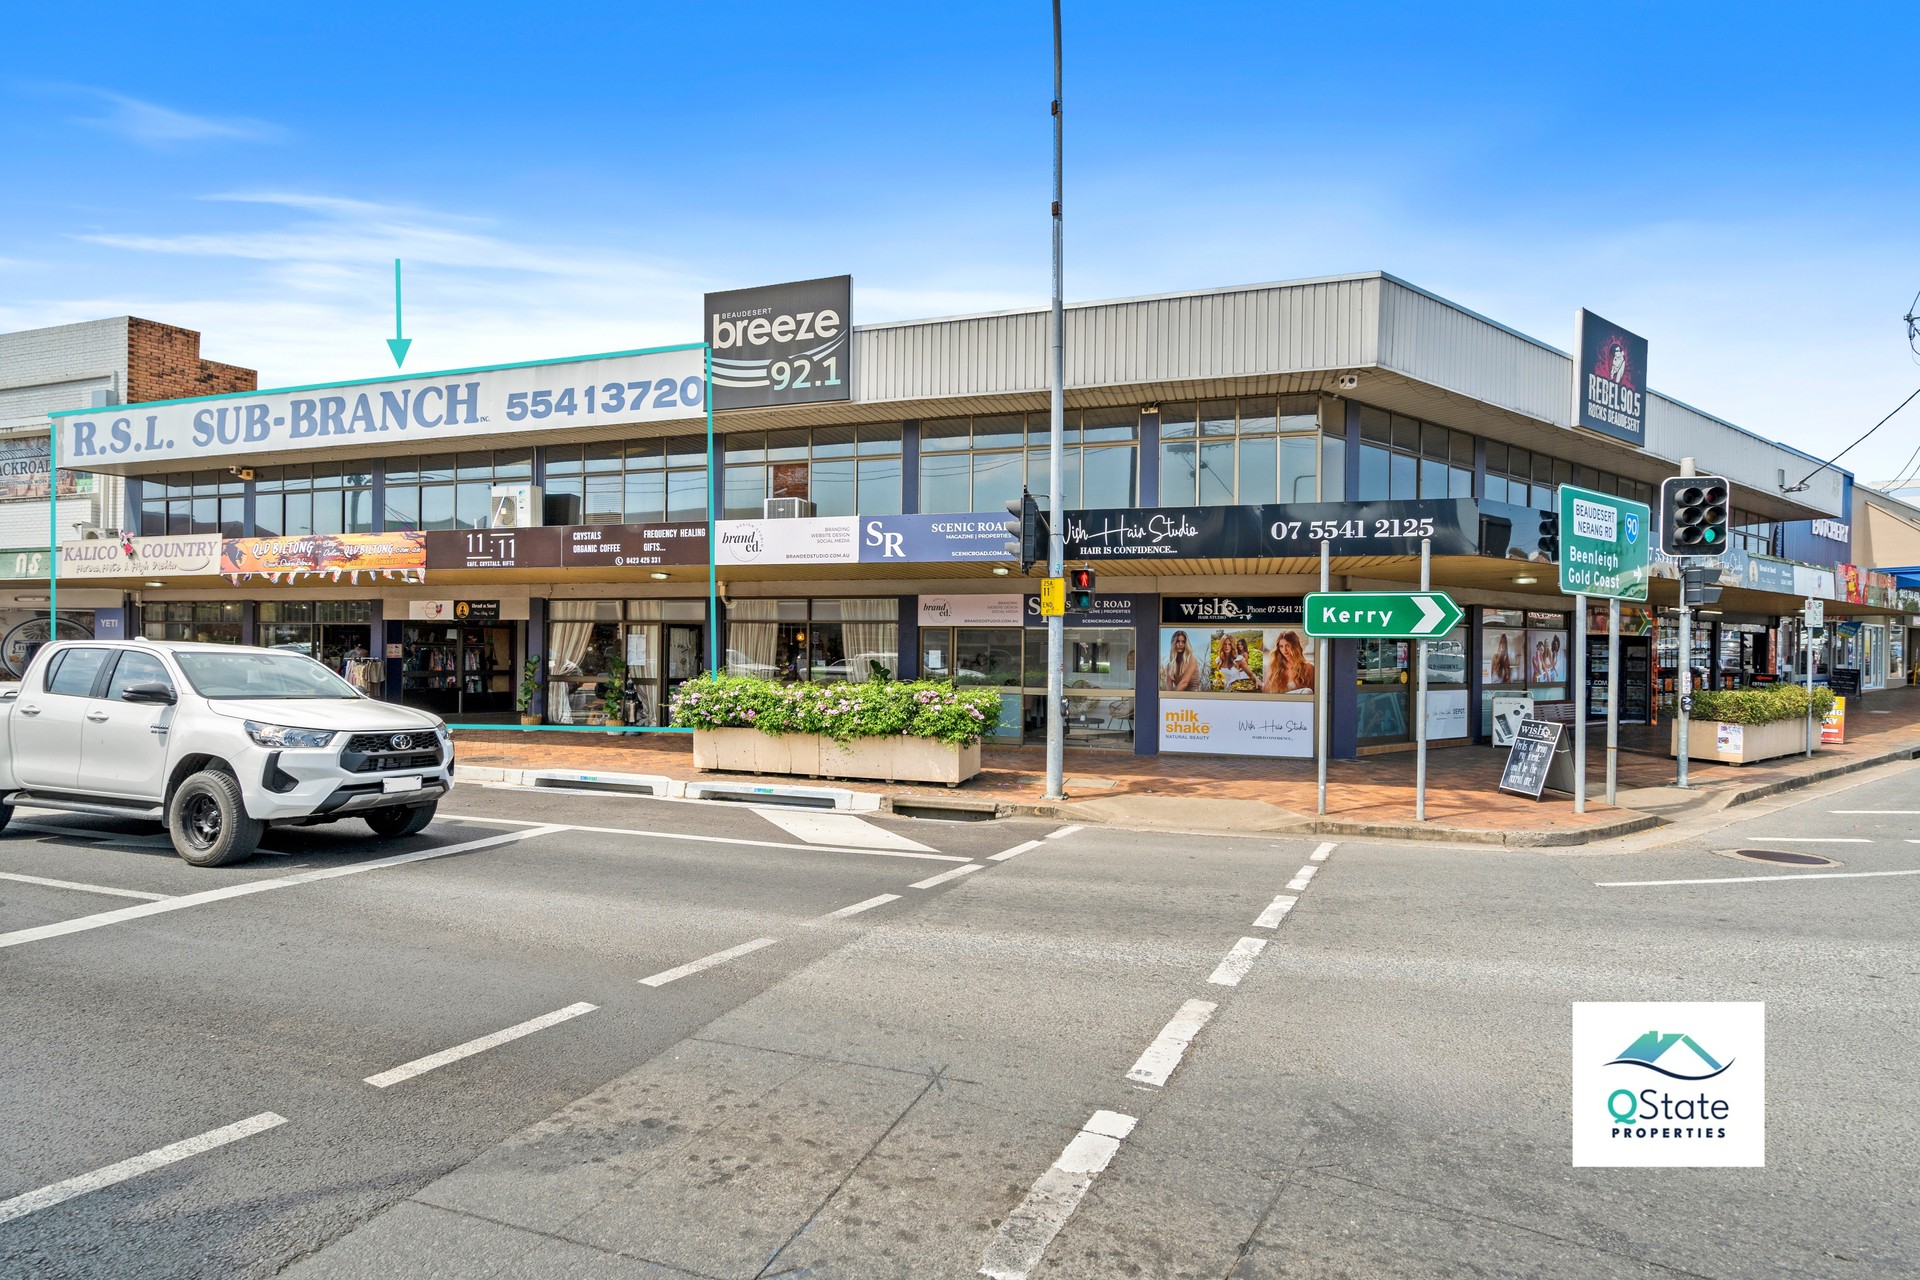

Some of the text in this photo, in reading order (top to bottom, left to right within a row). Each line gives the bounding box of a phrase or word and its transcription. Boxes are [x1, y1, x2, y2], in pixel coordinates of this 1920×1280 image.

[722, 308, 772, 319] BEAUDESERT
[713, 309, 840, 349] breeze
[771, 357, 841, 391] 92.1
[1588, 373, 1641, 417] REBEL 90.5
[73, 416, 174, 456] R.S.L.
[193, 382, 480, 447] SUB-BRANCH
[506, 375, 704, 421] 55413720
[1588, 402, 1640, 433] ROCKS BEAUDESERT
[1576, 504, 1615, 524] BEAUDESERT
[572, 527, 706, 540] CRYSTALS FREQUENCY HEALING
[931, 522, 974, 533] SCENIC
[1088, 515, 1147, 546] Hair
[1148, 514, 1199, 543] Studio
[1271, 517, 1434, 540] 07 5541 2125
[1577, 520, 1613, 539] NERANG RD
[1626, 517, 1638, 536] 90
[722, 531, 755, 544] brand
[745, 541, 762, 552] ed.
[64, 541, 218, 561] KALICO COUNTRY
[252, 541, 314, 560] QLD BILTONG
[572, 542, 666, 553] ORGANIC COFFEE GIFTS...
[1080, 545, 1178, 554] HAIR IS CONFIDENCE...
[1569, 545, 1619, 571] Beenleigh
[1568, 567, 1620, 589] Gold Coast
[923, 603, 947, 611] brand
[1103, 600, 1131, 608] ROAD
[1247, 605, 1266, 613] Phone
[1267, 605, 1276, 613] 07
[1277, 605, 1293, 613] 5541
[100, 618, 118, 628] YETI
[1322, 606, 1393, 627] Kerry
[1165, 709, 1199, 722] milk
[1165, 721, 1210, 734] shake
